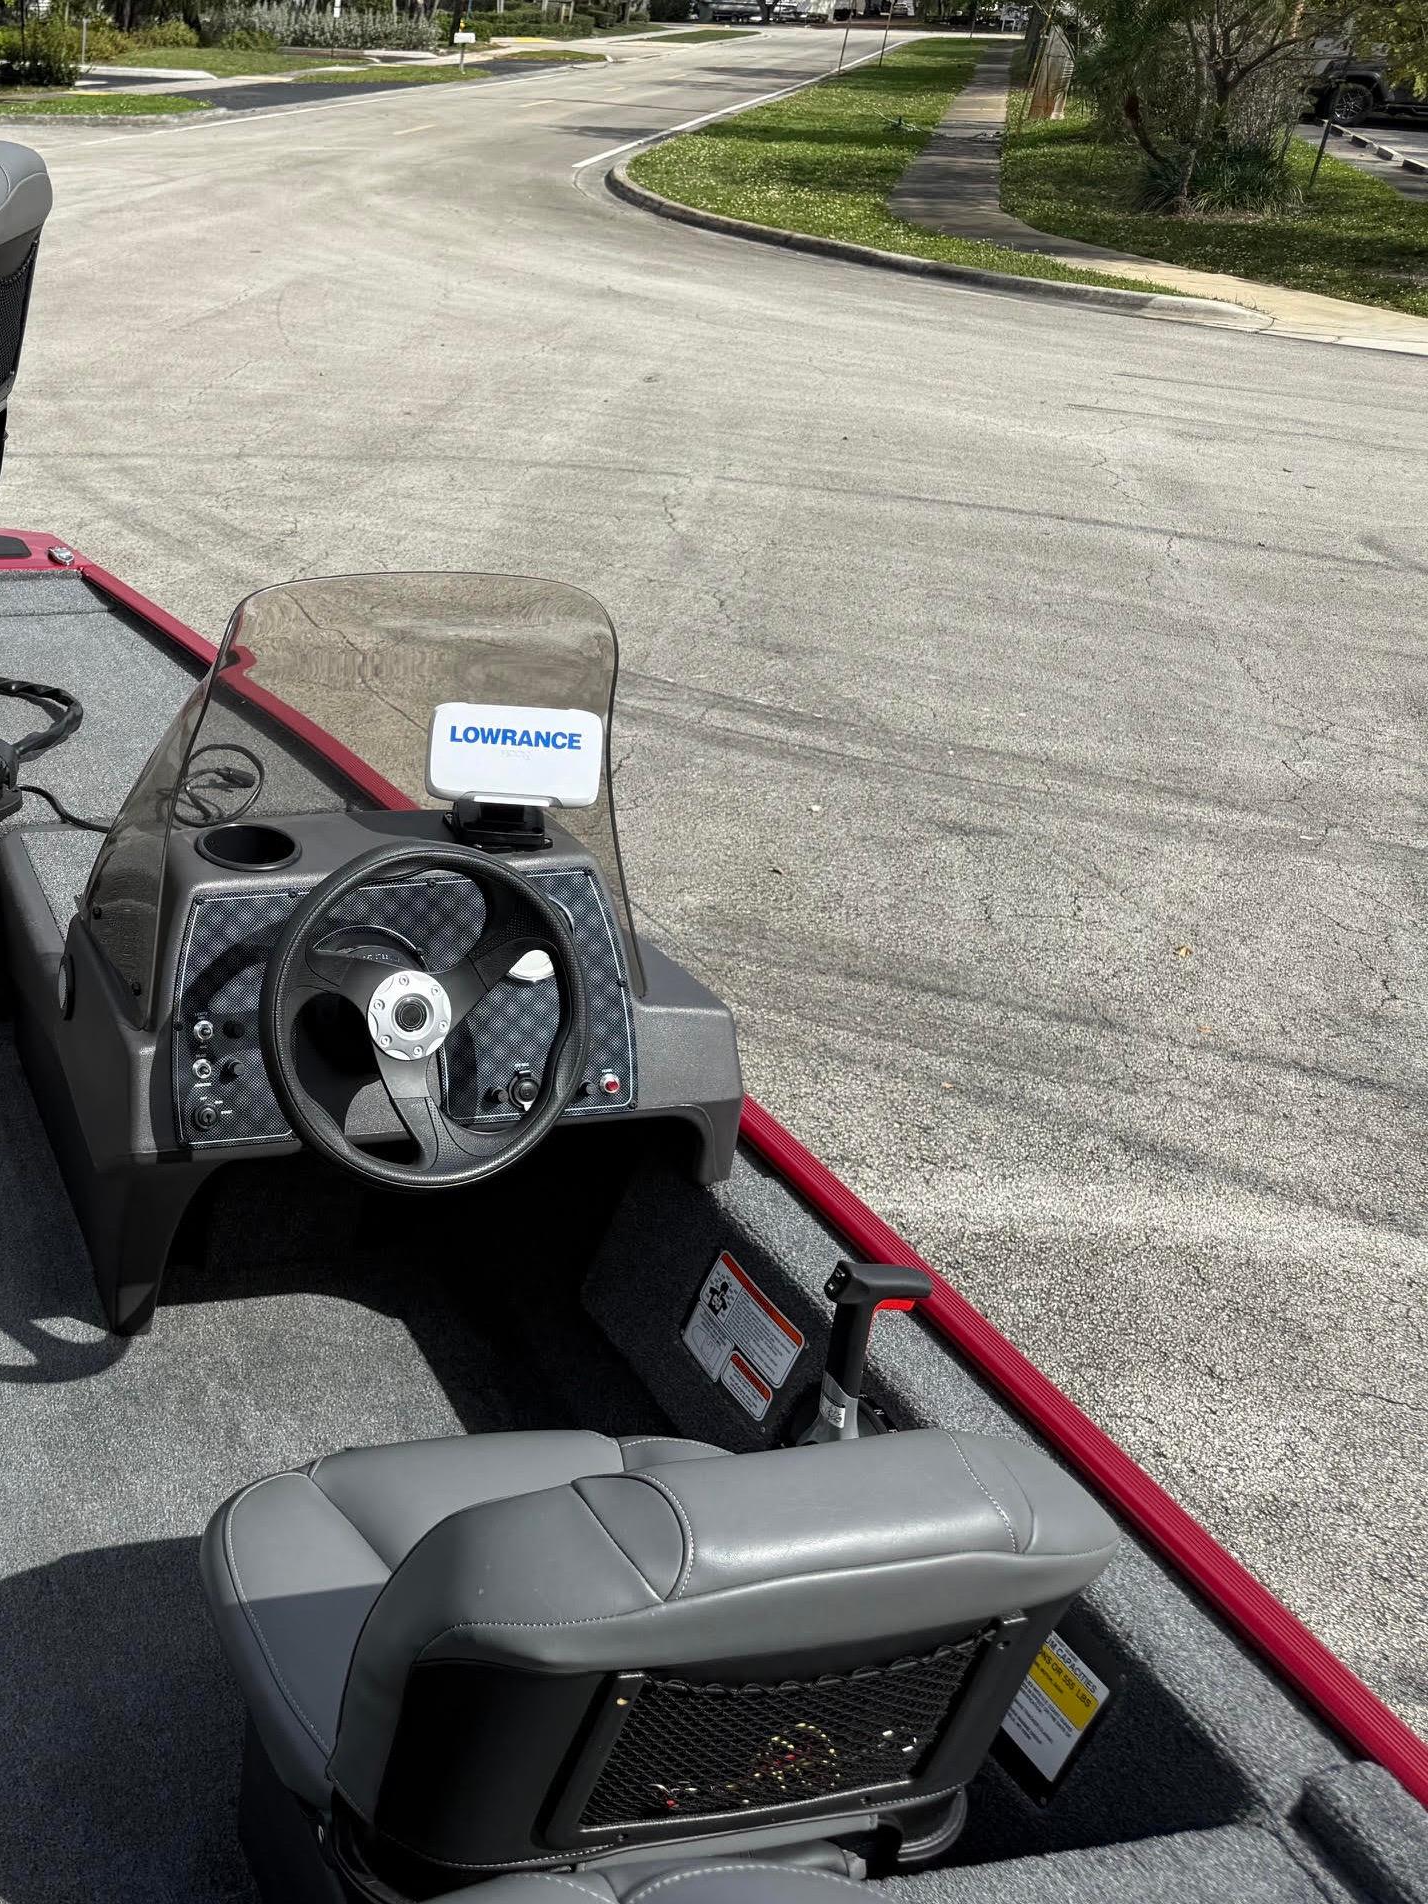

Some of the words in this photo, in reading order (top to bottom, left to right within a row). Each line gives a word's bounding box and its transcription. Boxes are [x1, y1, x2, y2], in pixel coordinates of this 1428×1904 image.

[449, 725, 582, 750] LOWRANCE
[1057, 1648, 1097, 1694] CAPACITIES
[1076, 1688, 1092, 1708] LBS
